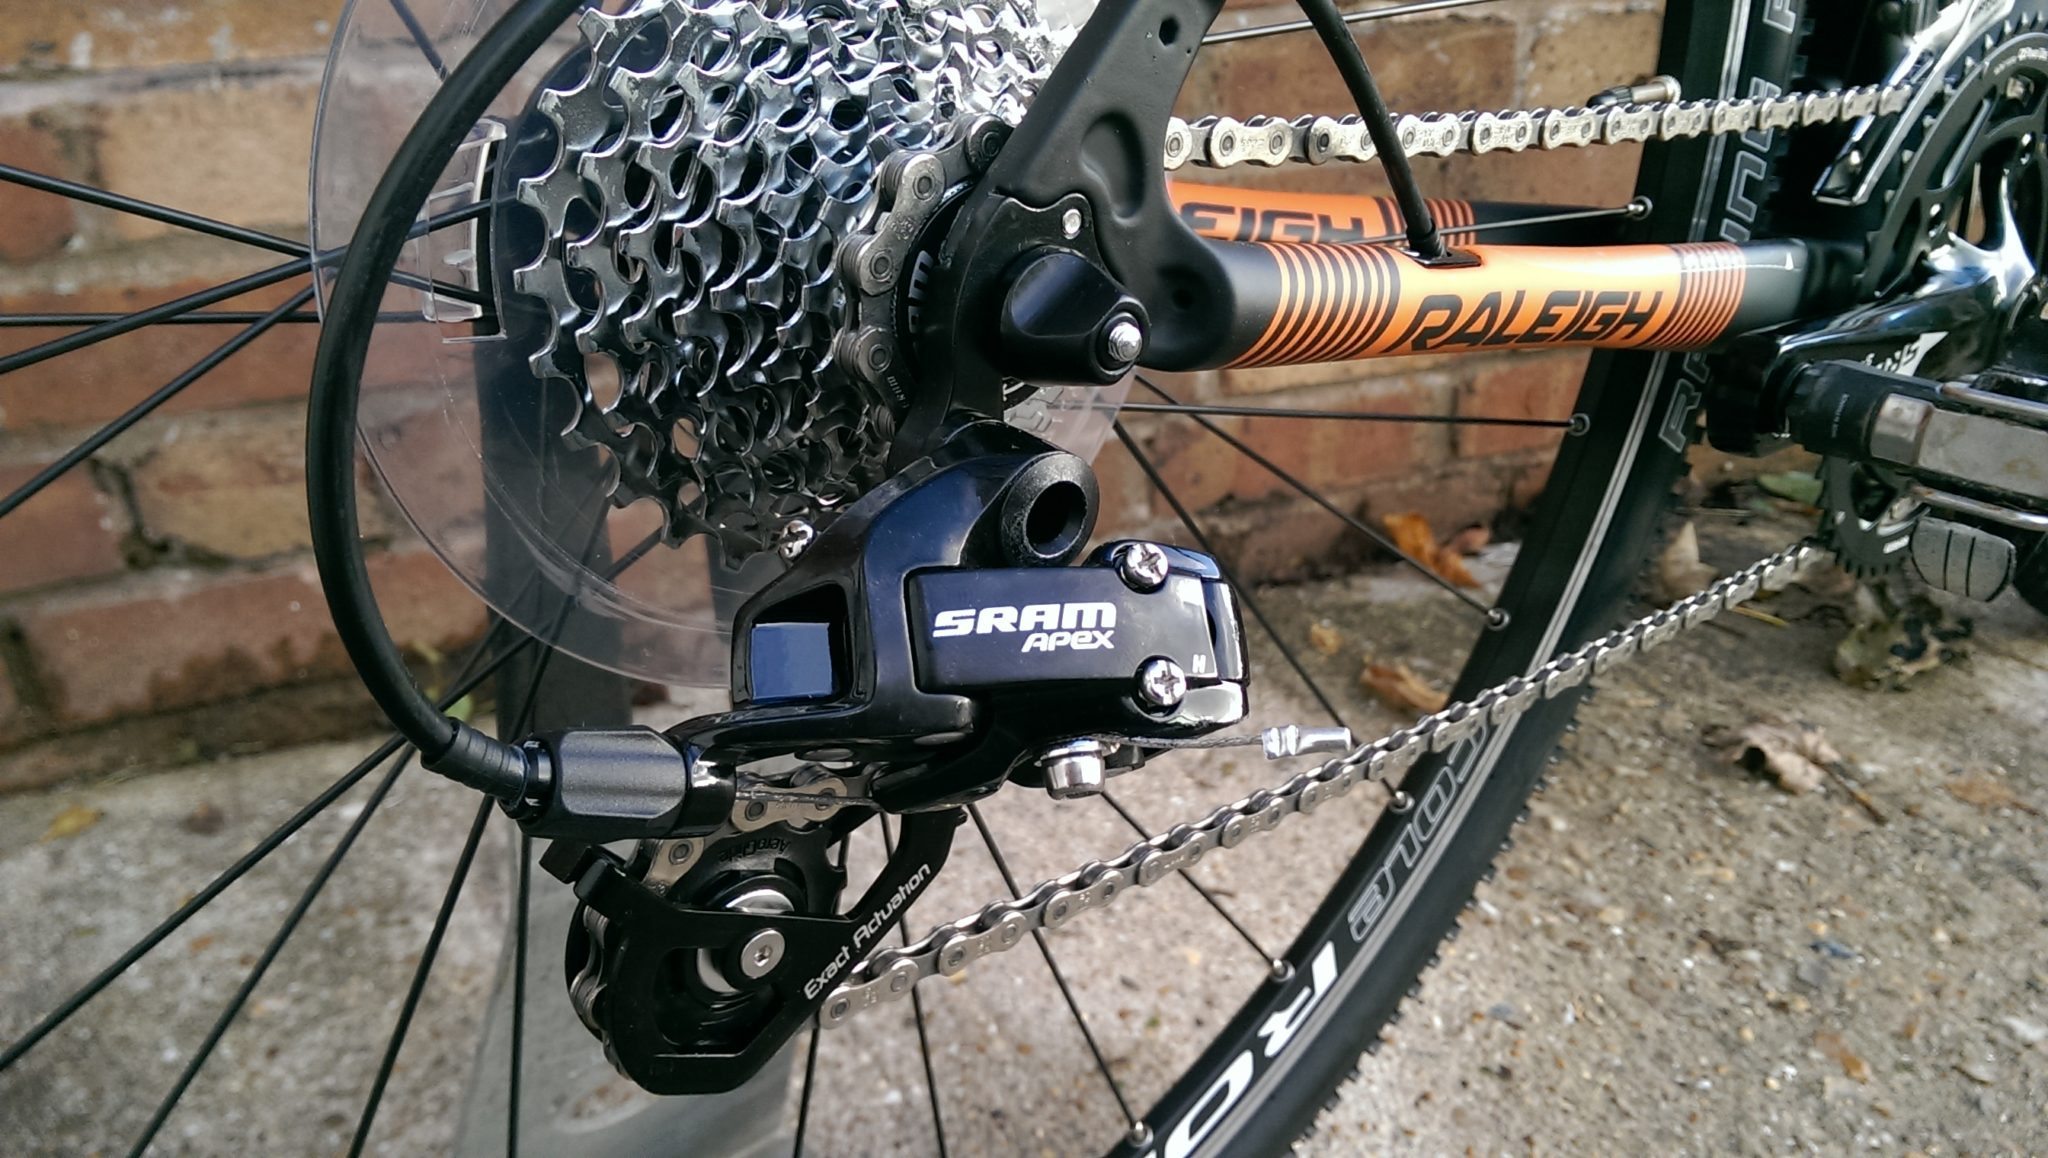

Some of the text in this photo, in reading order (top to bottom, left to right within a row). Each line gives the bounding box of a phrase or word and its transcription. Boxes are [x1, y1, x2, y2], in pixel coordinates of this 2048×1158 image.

[1180, 201, 1366, 246] EIGH
[1383, 289, 1665, 353] RALEIGH
[932, 600, 1117, 637] SRAM
[803, 863, 932, 1001] Exact Actuation
[1139, 939, 1339, 1158] RO
